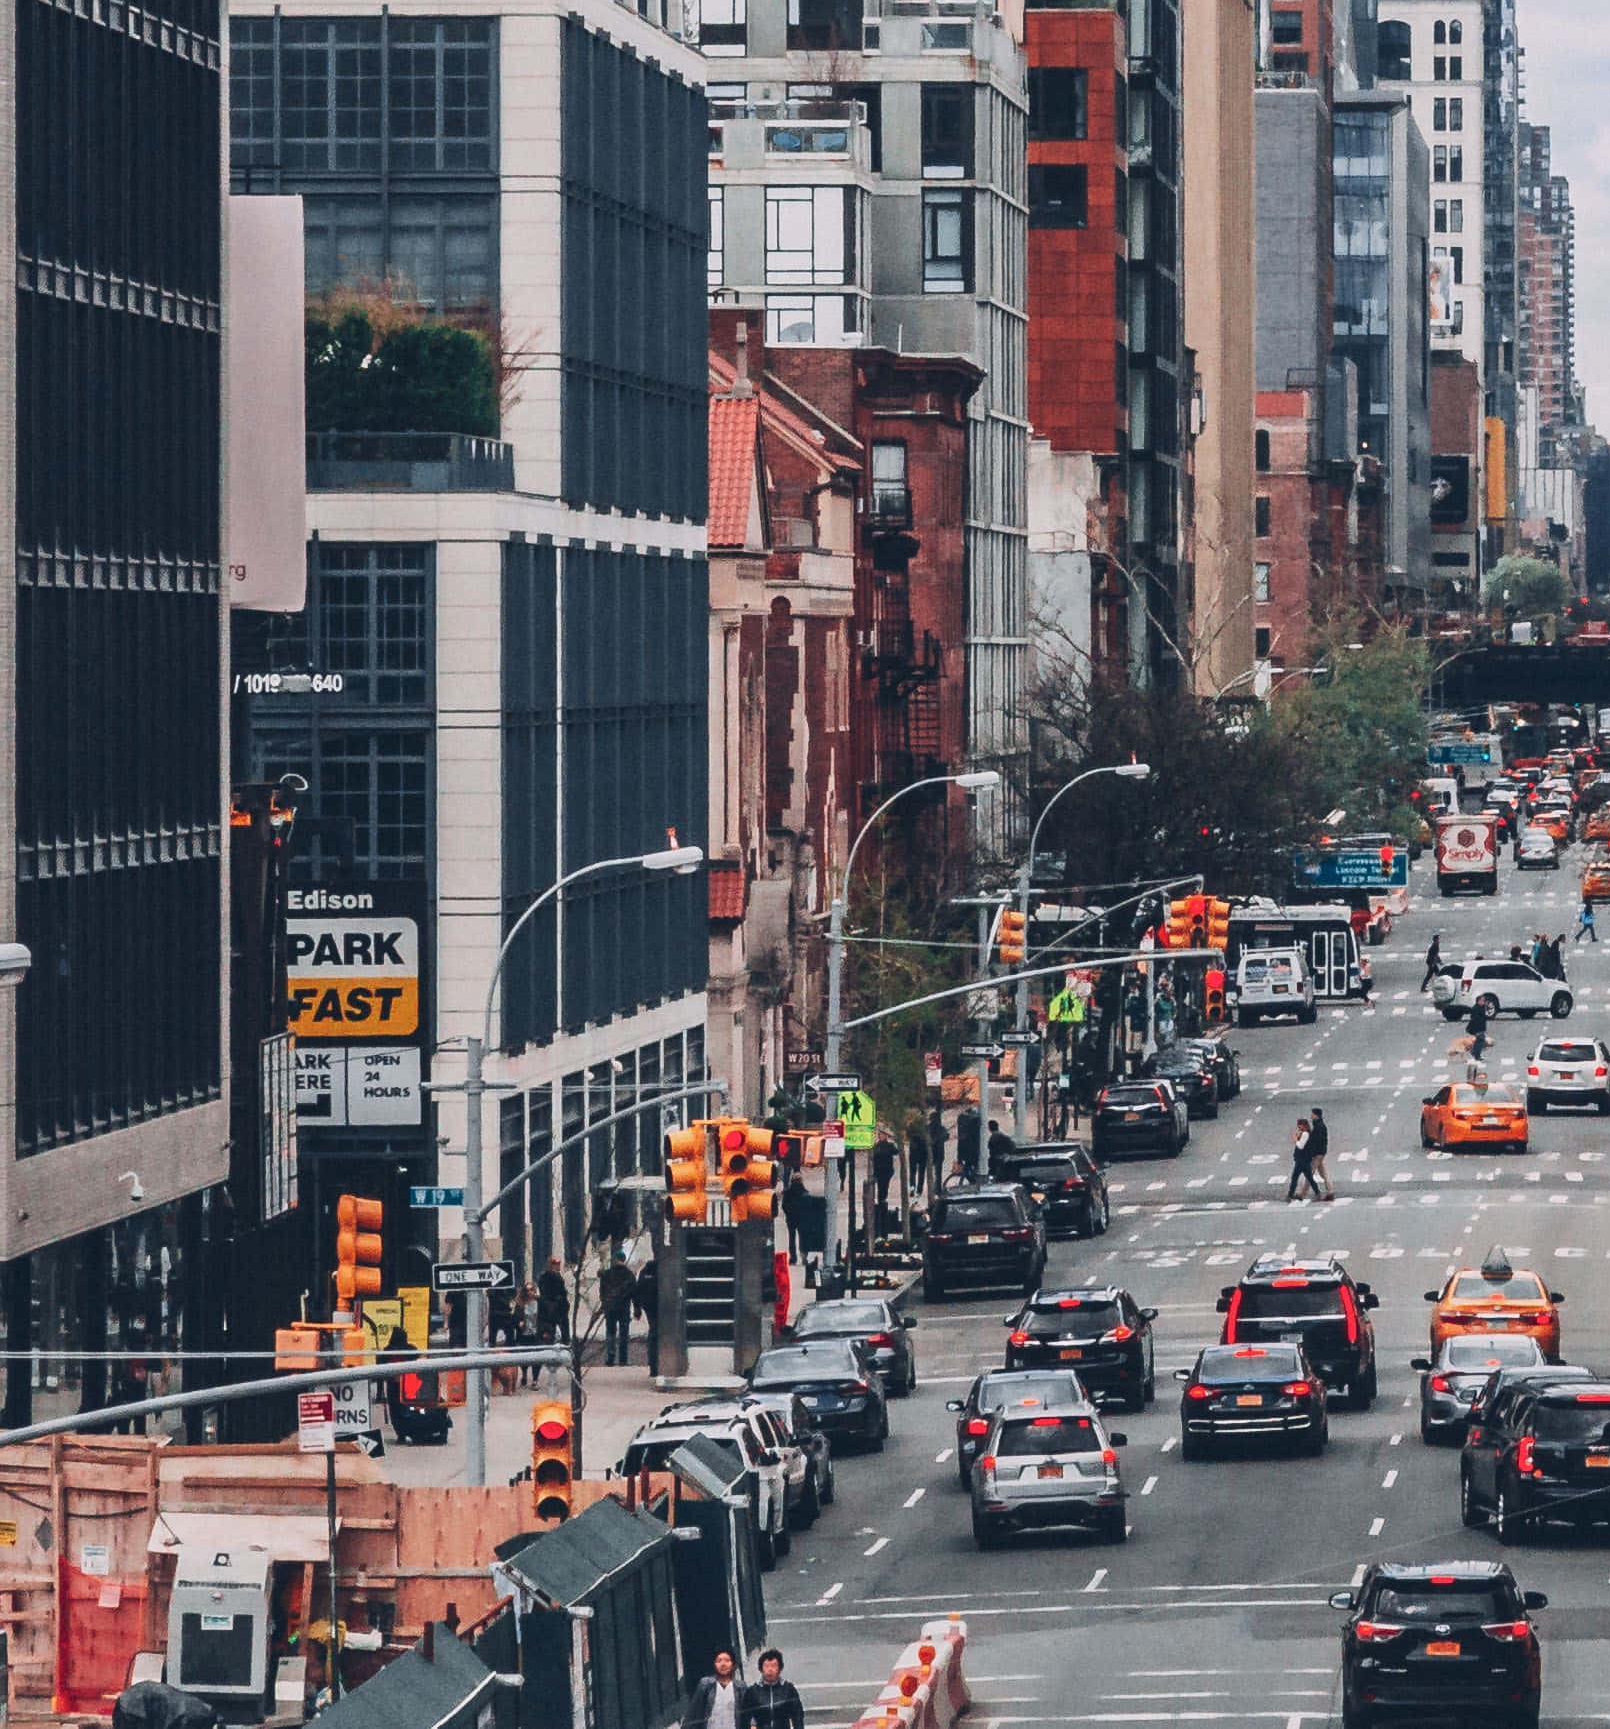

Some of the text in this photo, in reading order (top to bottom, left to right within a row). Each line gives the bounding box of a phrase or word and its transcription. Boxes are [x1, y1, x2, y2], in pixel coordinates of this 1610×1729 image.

[287, 889, 374, 910] Edison
[287, 932, 405, 966] PARK
[289, 987, 403, 1023] FAST
[296, 1053, 332, 1070] ARK
[364, 1055, 401, 1067] OPEN
[296, 1074, 332, 1090] ERE
[365, 1071, 380, 1082] 24
[364, 1086, 411, 1099] HOURS
[415, 1189, 427, 1205] W
[432, 1189, 446, 1205] 19
[445, 1269, 501, 1284] ONE WAY
[329, 1385, 354, 1402] NO
[336, 1409, 368, 1424] RNS
